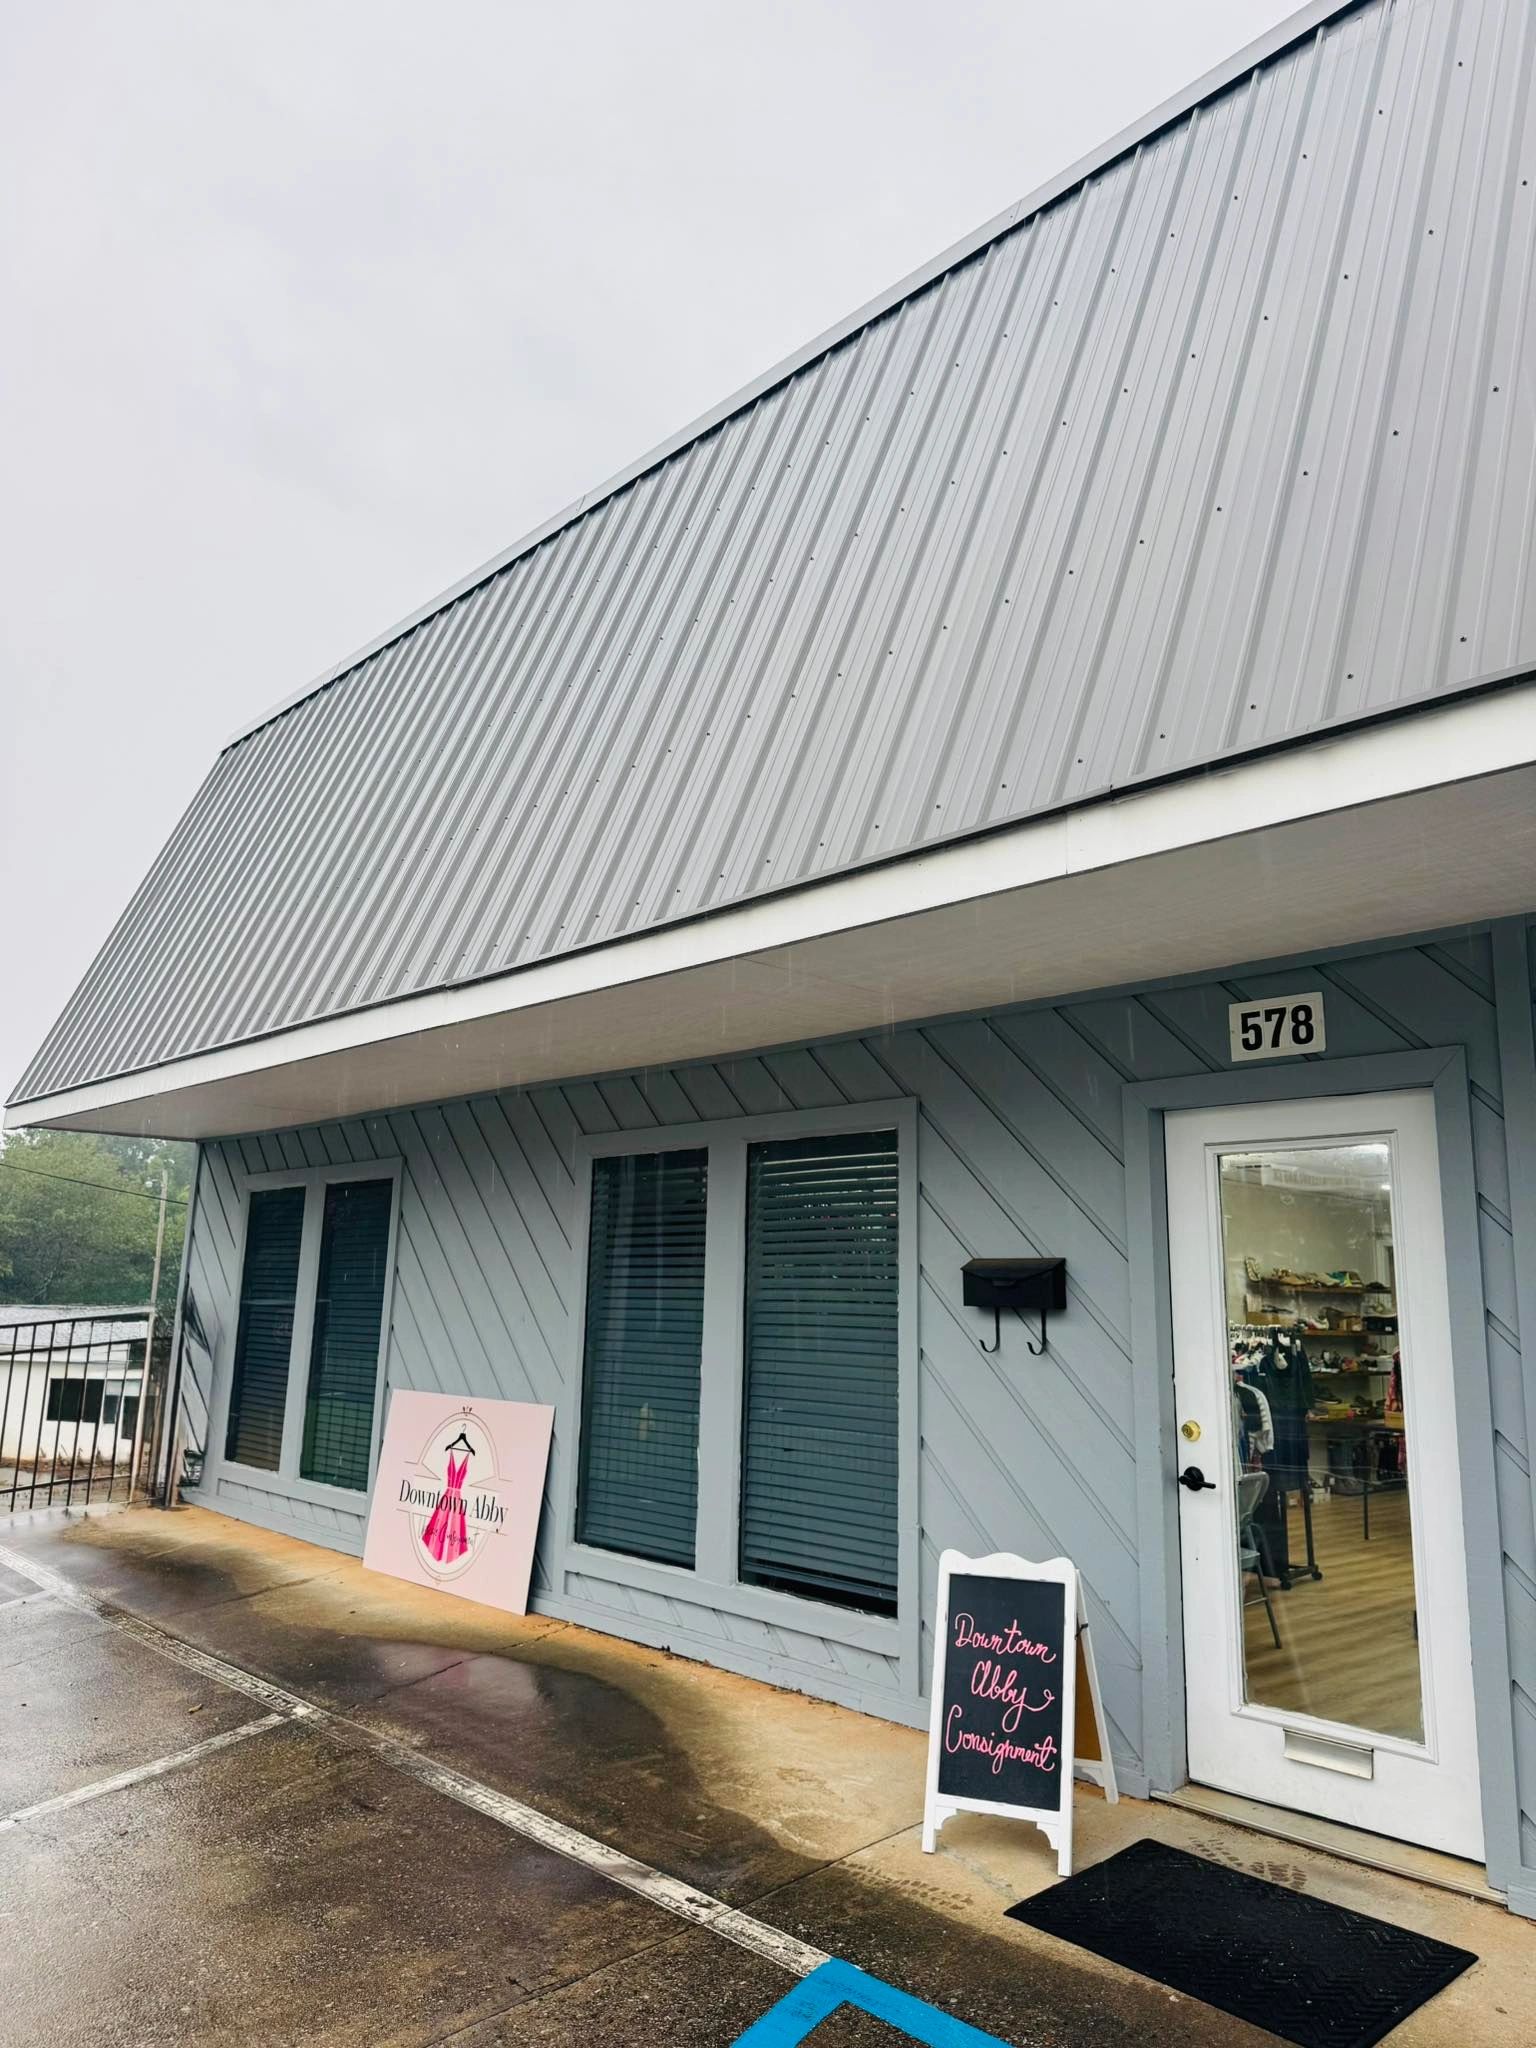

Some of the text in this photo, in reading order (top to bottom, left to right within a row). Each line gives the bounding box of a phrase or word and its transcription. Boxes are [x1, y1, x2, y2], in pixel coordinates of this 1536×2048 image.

[1240, 1004, 1314, 1051] 578
[399, 1479, 468, 1516] Downtown
[469, 1494, 509, 1533] Abby
[954, 1612, 1057, 1664] Downtown
[945, 1704, 1057, 1775] Consignment
